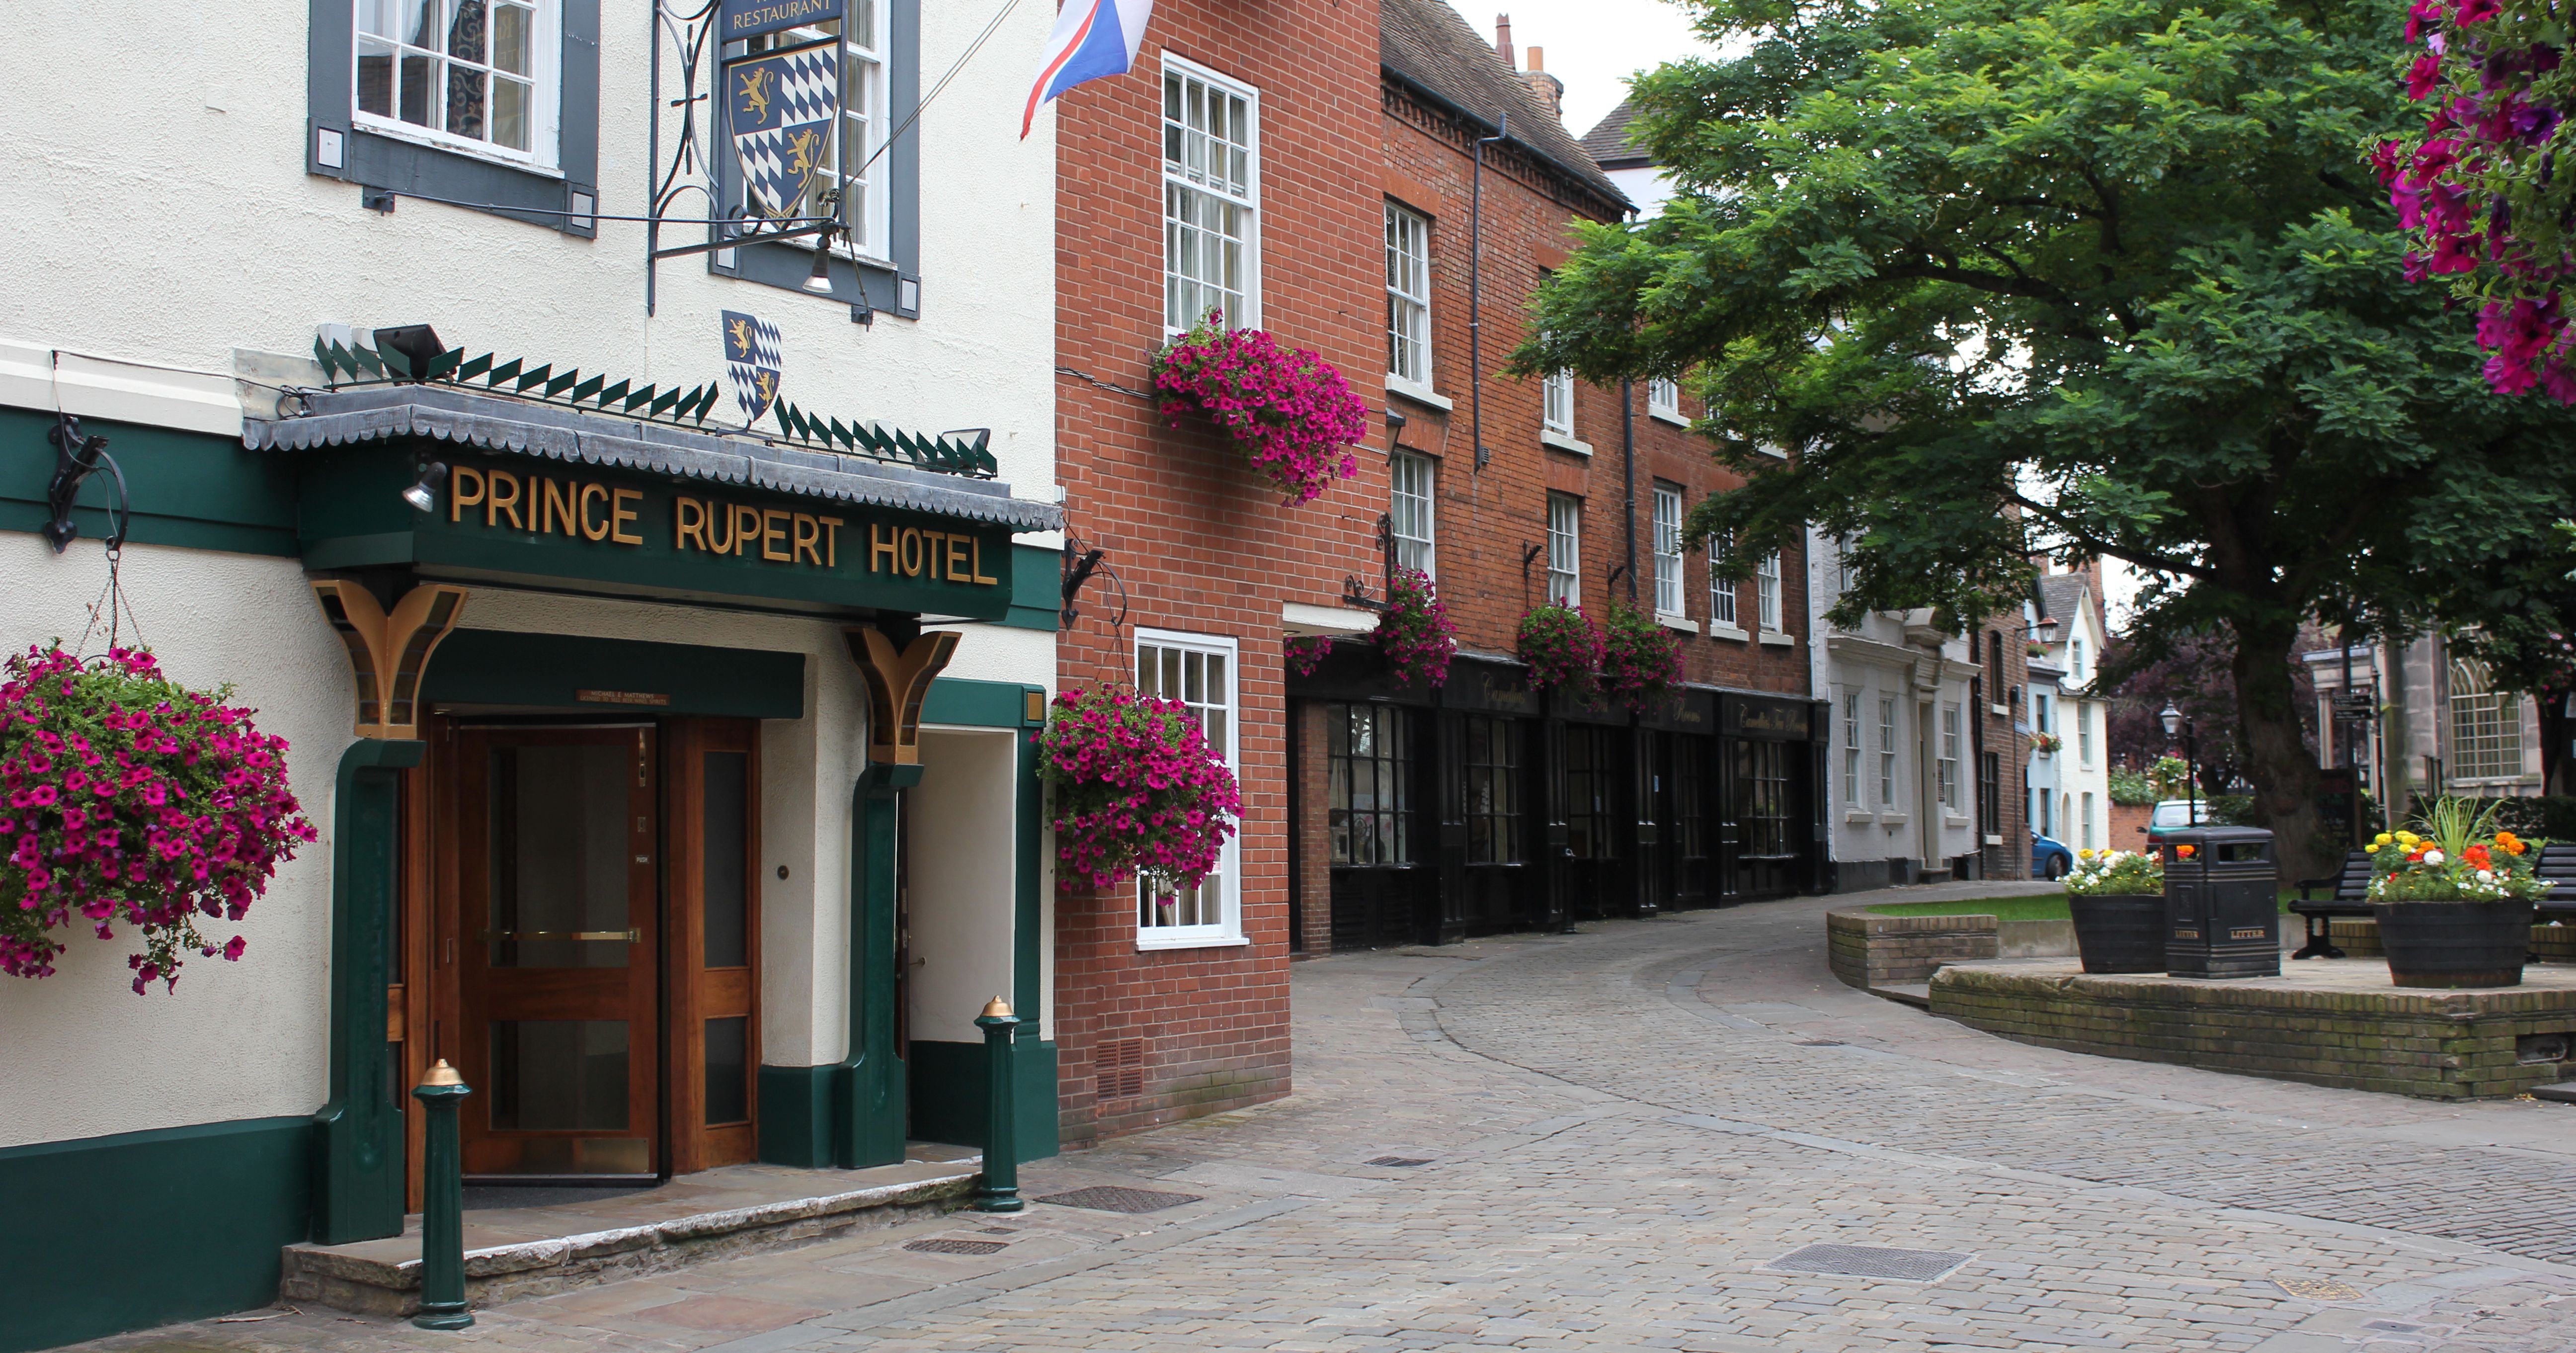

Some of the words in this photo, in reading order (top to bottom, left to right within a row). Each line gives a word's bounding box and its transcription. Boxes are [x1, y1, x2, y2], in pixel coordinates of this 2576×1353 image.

[733, 0, 830, 30] RESTAURANT
[452, 465, 643, 545] PRINCE
[677, 497, 844, 567] RUPERT
[871, 523, 998, 585] HOTEL
[2231, 930, 2265, 938] LITTER
